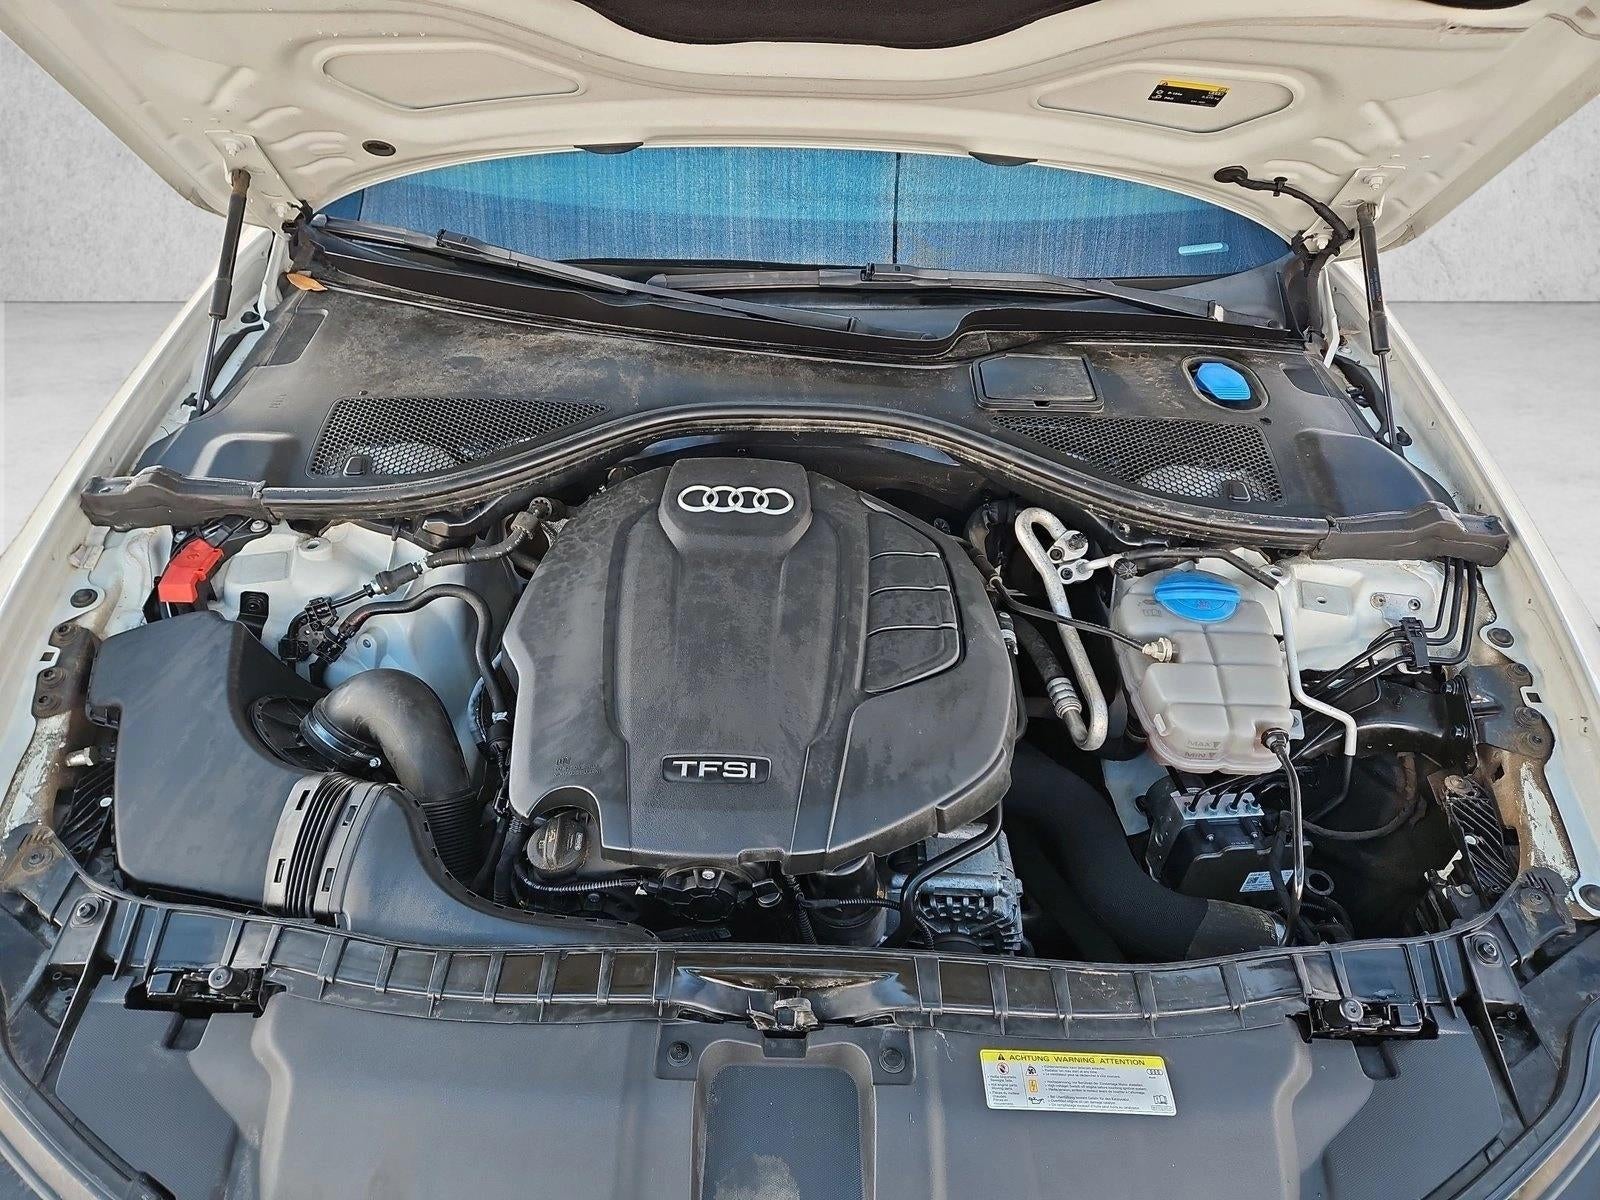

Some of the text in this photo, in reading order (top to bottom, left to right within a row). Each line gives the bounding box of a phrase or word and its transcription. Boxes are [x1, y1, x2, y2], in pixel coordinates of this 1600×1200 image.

[672, 760, 757, 779] TFSI
[1009, 1054, 1145, 1066] ACHTUNG WARNING ATTENTION
